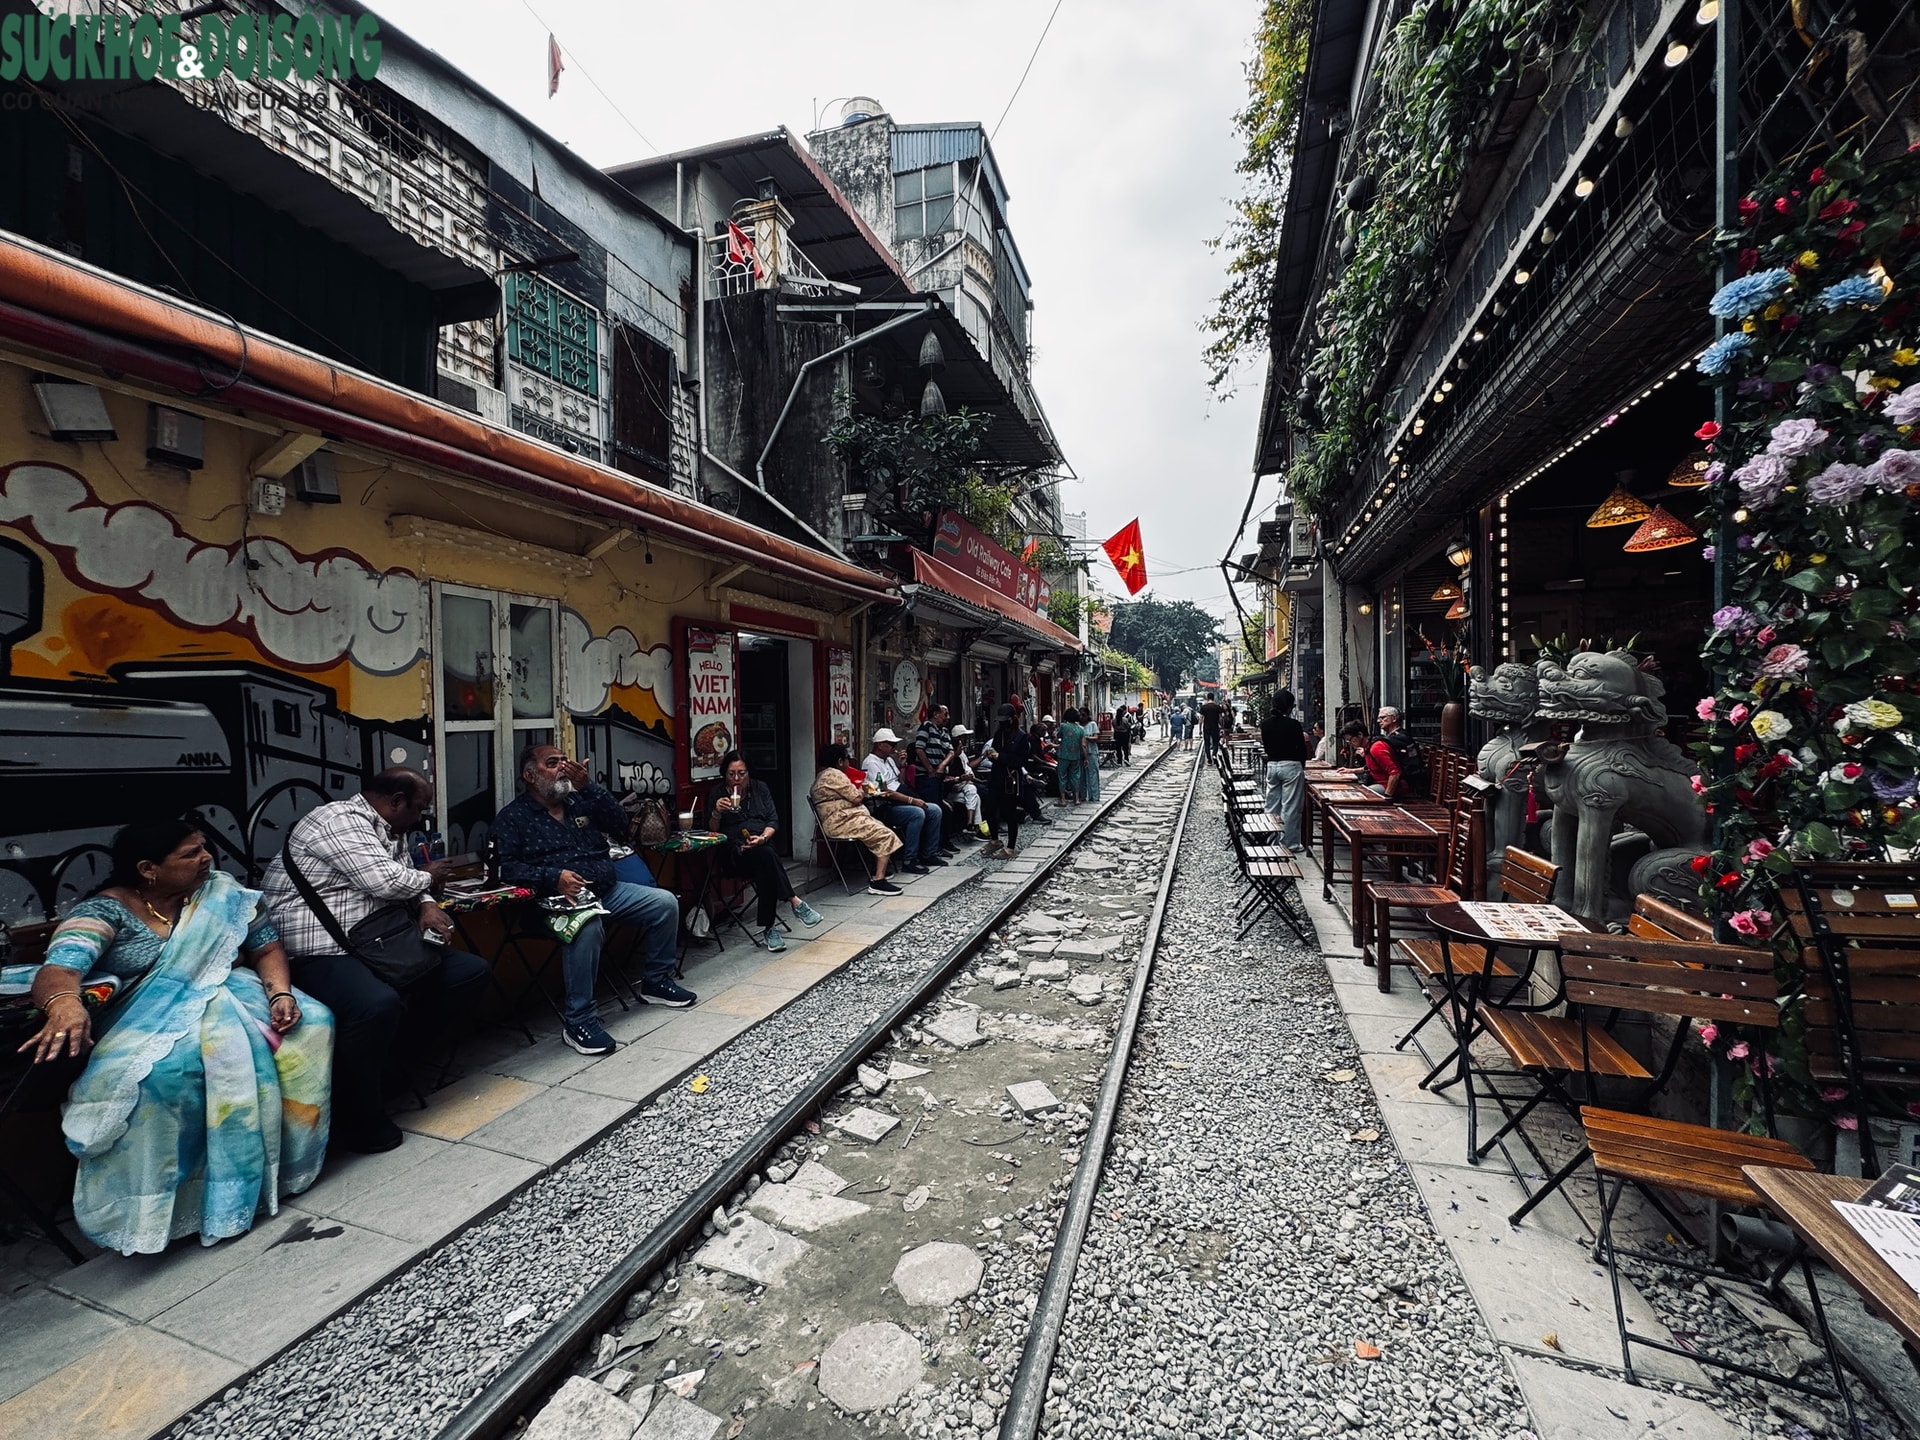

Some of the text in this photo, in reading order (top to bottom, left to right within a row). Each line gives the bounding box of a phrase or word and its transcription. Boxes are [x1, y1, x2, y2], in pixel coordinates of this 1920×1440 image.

[966, 537, 979, 558] Old
[699, 660, 723, 672] HELLO
[692, 674, 730, 693] VIET
[834, 682, 848, 698] HA
[692, 696, 731, 715] NAM
[832, 700, 850, 715] NOI
[176, 752, 226, 767] ANNA
